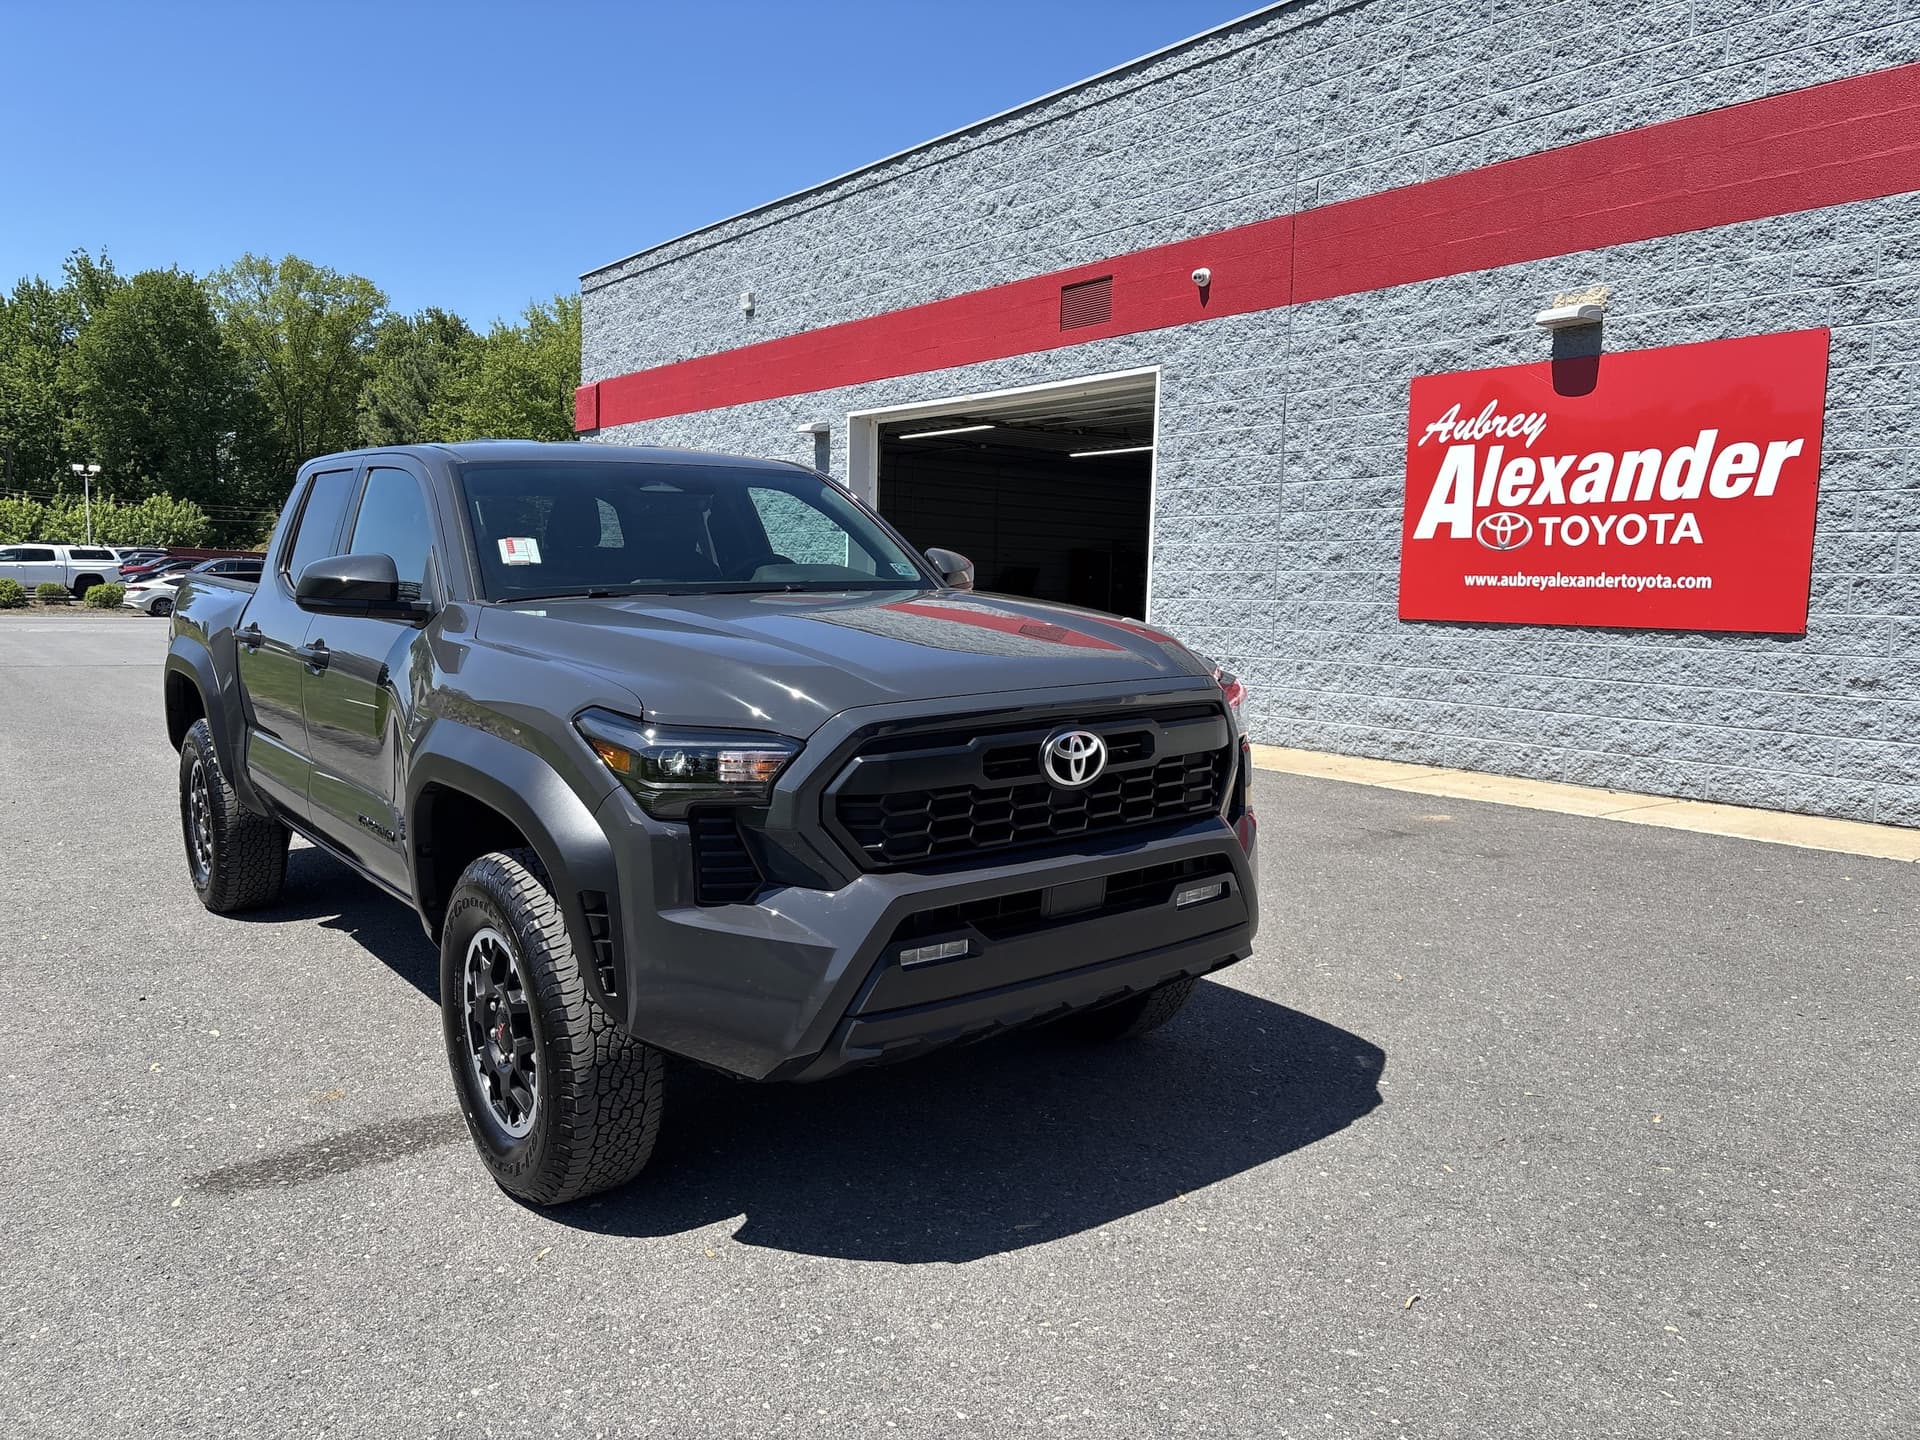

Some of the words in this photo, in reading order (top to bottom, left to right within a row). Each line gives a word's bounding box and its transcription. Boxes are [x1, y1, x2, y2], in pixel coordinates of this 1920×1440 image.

[1418, 398, 1547, 448] Aubrey
[1412, 428, 1805, 540] Alexander
[1537, 512, 1704, 547] TOYOTA
[1464, 571, 1712, 593] www.aubreyalexandertoyota.com
